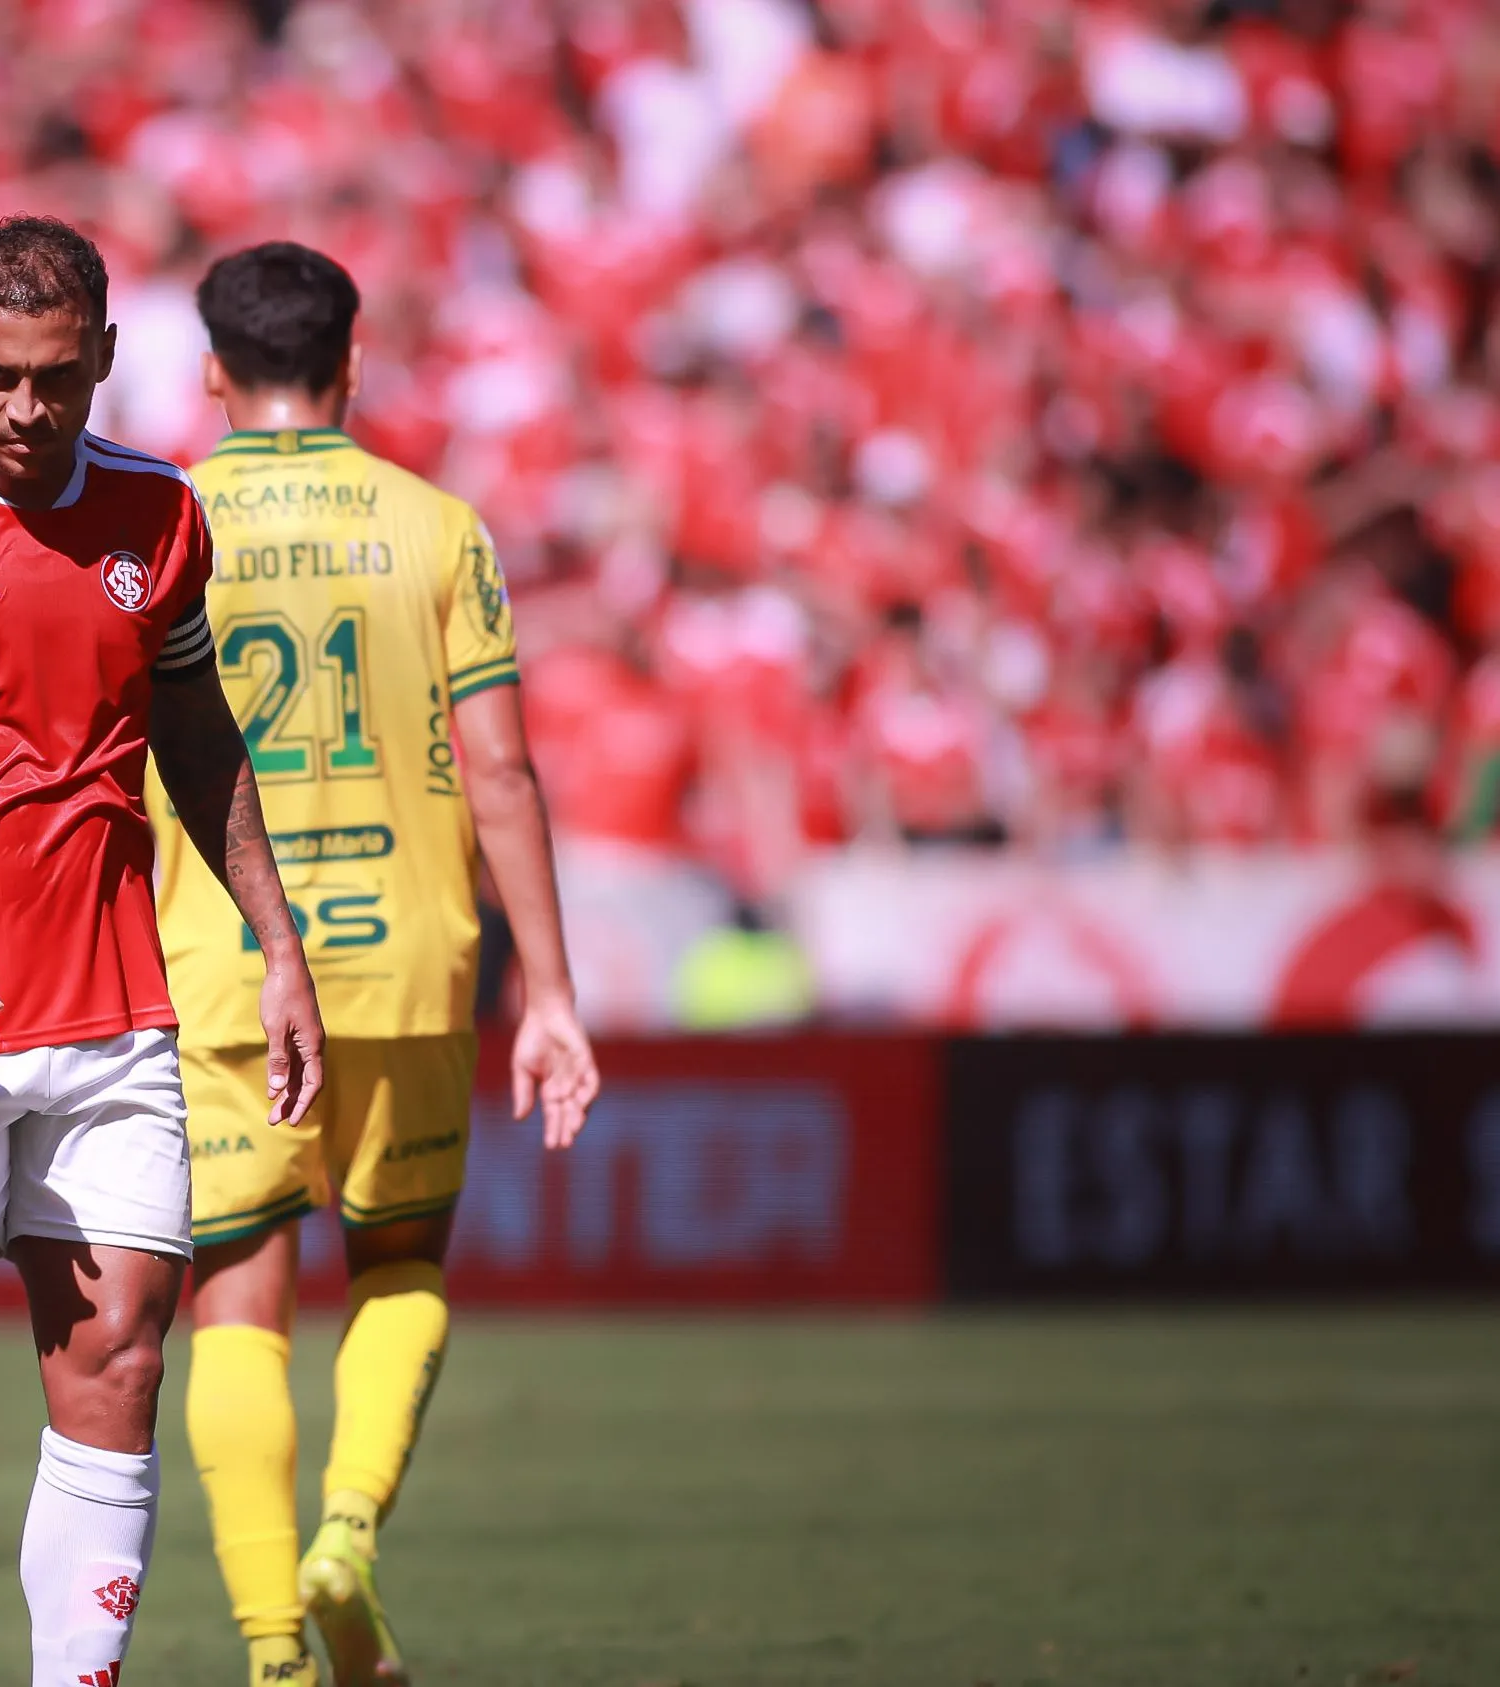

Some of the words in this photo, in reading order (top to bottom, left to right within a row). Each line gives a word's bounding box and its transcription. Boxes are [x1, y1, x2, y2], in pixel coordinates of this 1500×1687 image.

[213, 545, 281, 585] LDO
[288, 540, 393, 579] FILHO
[218, 606, 384, 786] 21
